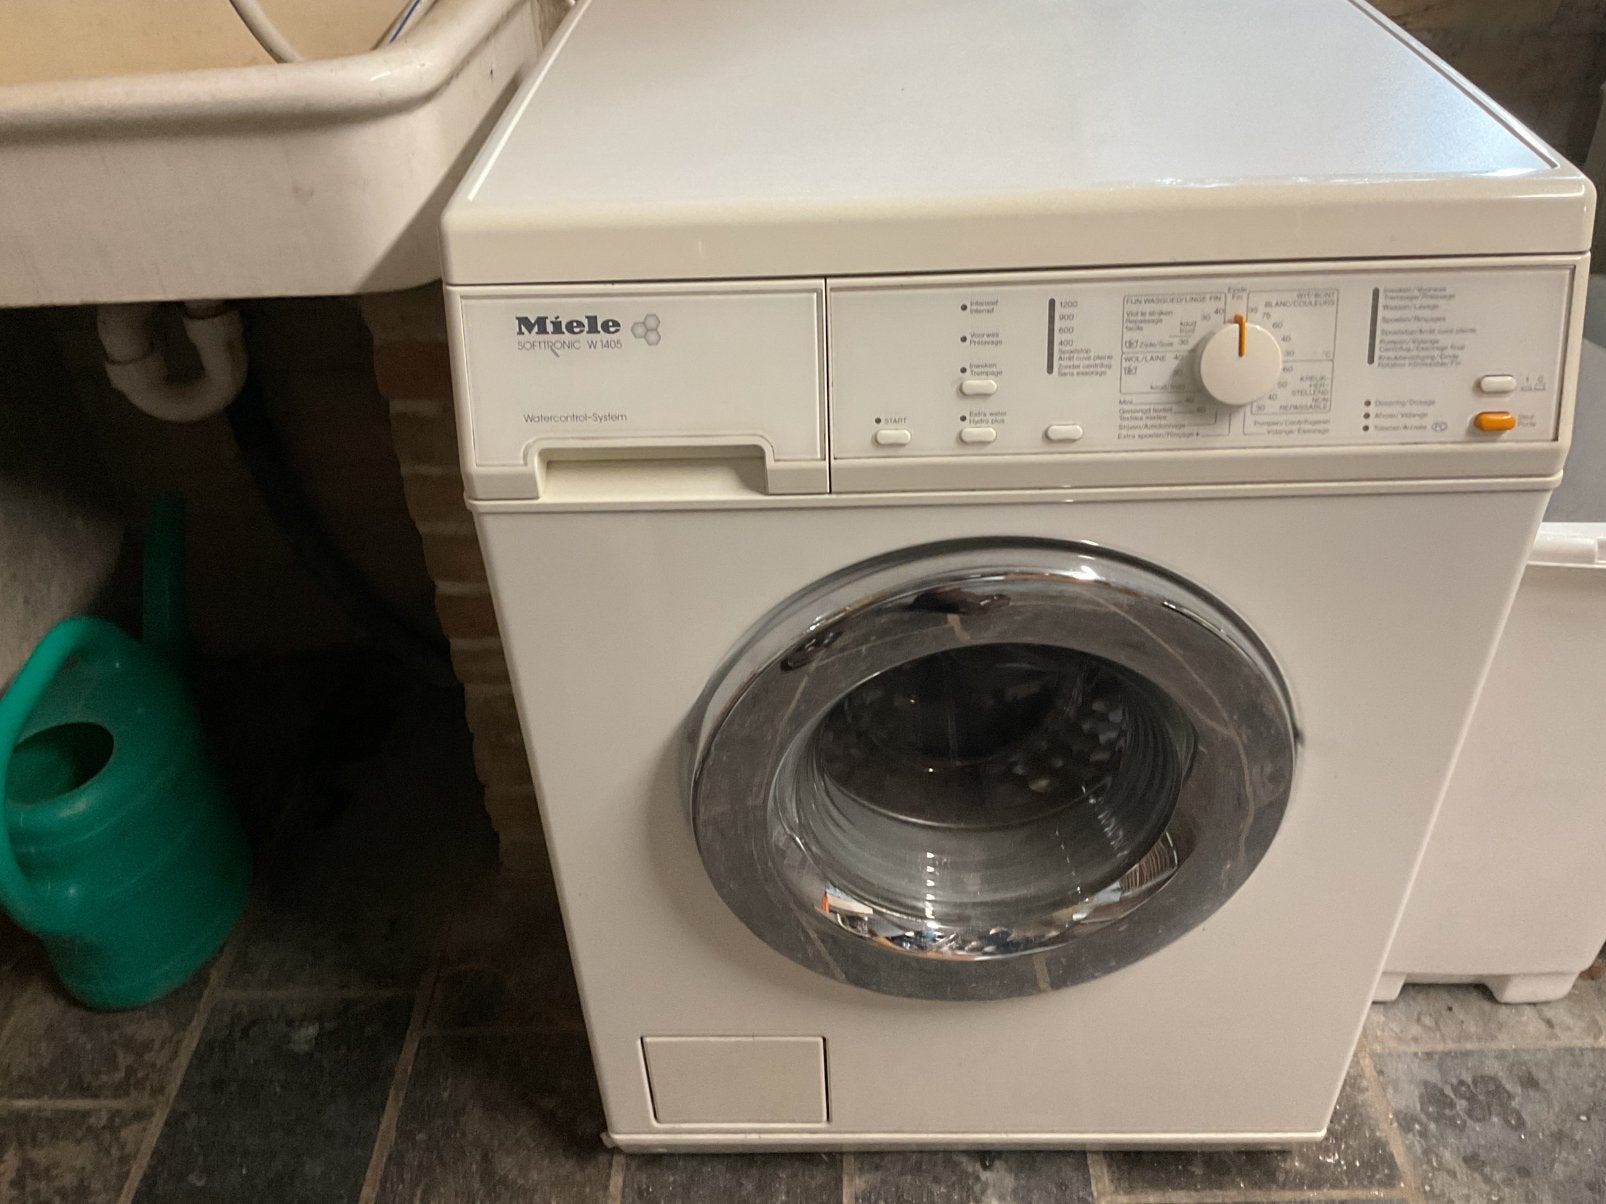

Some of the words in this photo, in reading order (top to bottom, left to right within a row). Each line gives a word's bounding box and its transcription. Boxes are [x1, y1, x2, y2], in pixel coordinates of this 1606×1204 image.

[1059, 300, 1078, 308] 1200
[1214, 307, 1224, 315] 40
[1058, 313, 1075, 321] 900
[516, 315, 621, 335] Miele
[1272, 321, 1283, 329] 60
[1058, 326, 1075, 334] 600
[517, 340, 581, 355] SOFTTRONIC
[587, 339, 598, 350] W
[600, 339, 622, 350] 1405
[1058, 339, 1074, 347] 400
[1123, 354, 1166, 363] WOL/LAINE
[523, 412, 627, 424] Watercontrol-System
[969, 417, 989, 425] Hydro
[991, 417, 1005, 425] plus
